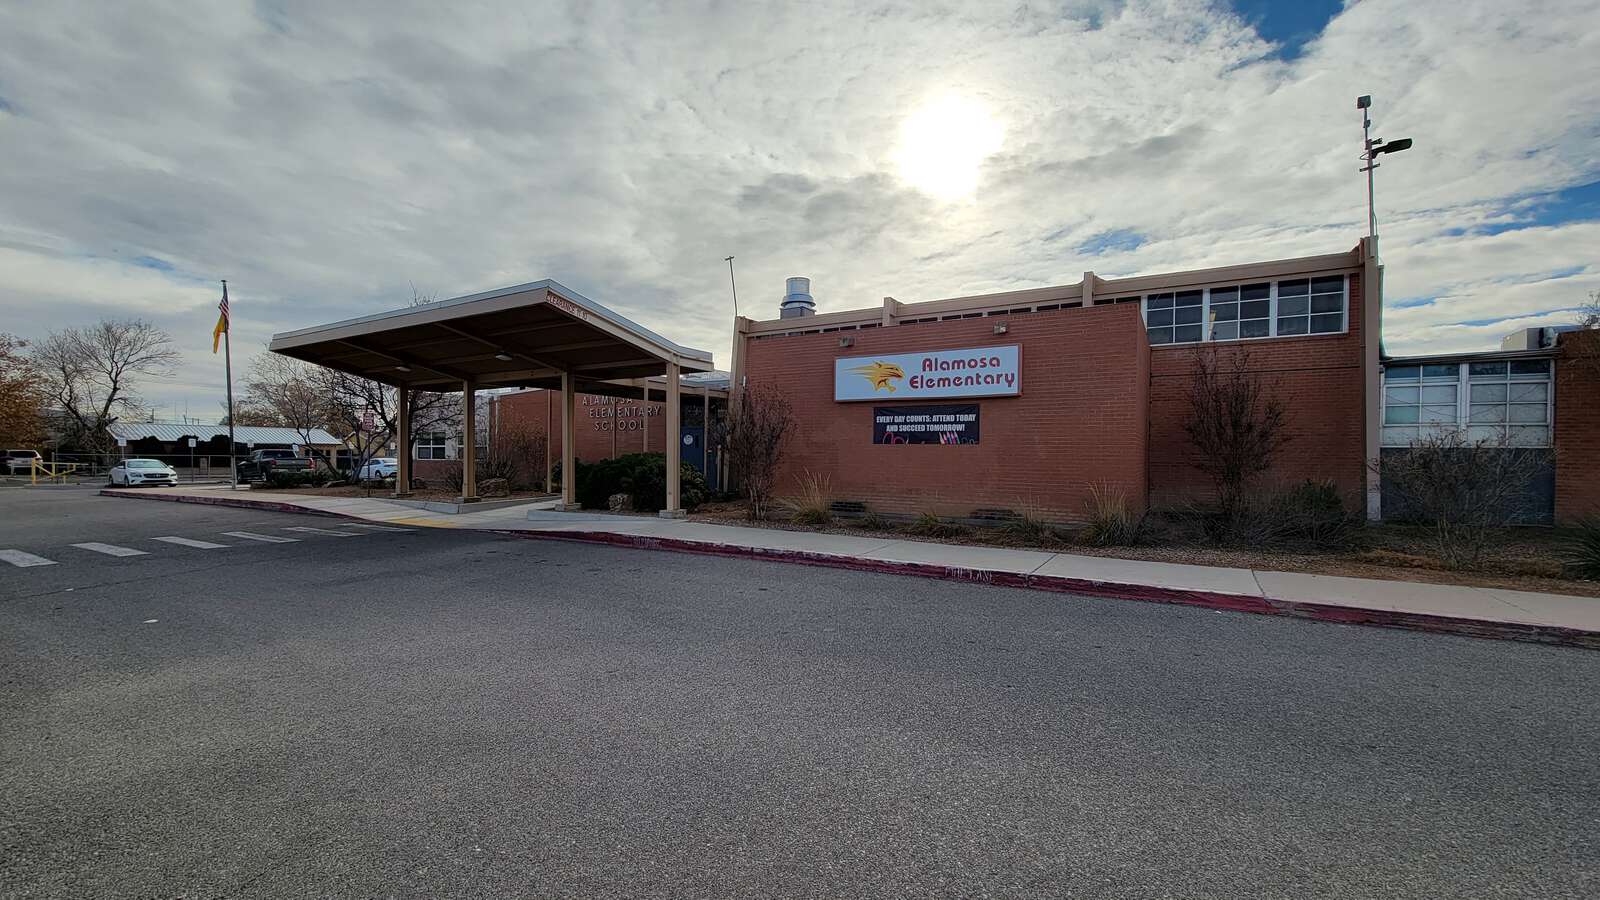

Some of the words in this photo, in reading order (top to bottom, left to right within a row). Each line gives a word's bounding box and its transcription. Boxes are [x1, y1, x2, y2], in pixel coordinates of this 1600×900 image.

[922, 357, 1000, 371] Alamosa
[909, 373, 1015, 388] Elementary
[589, 405, 661, 418] ELEMENTARY
[876, 415, 894, 423] EVERY
[894, 415, 906, 423] DAY
[906, 415, 932, 423] COUNTS:
[932, 414, 955, 422] ATTEND
[956, 414, 976, 422] TODAY
[886, 424, 898, 432] AND
[899, 424, 926, 432] SUCCEED
[927, 423, 965, 432] TOMORROW!
